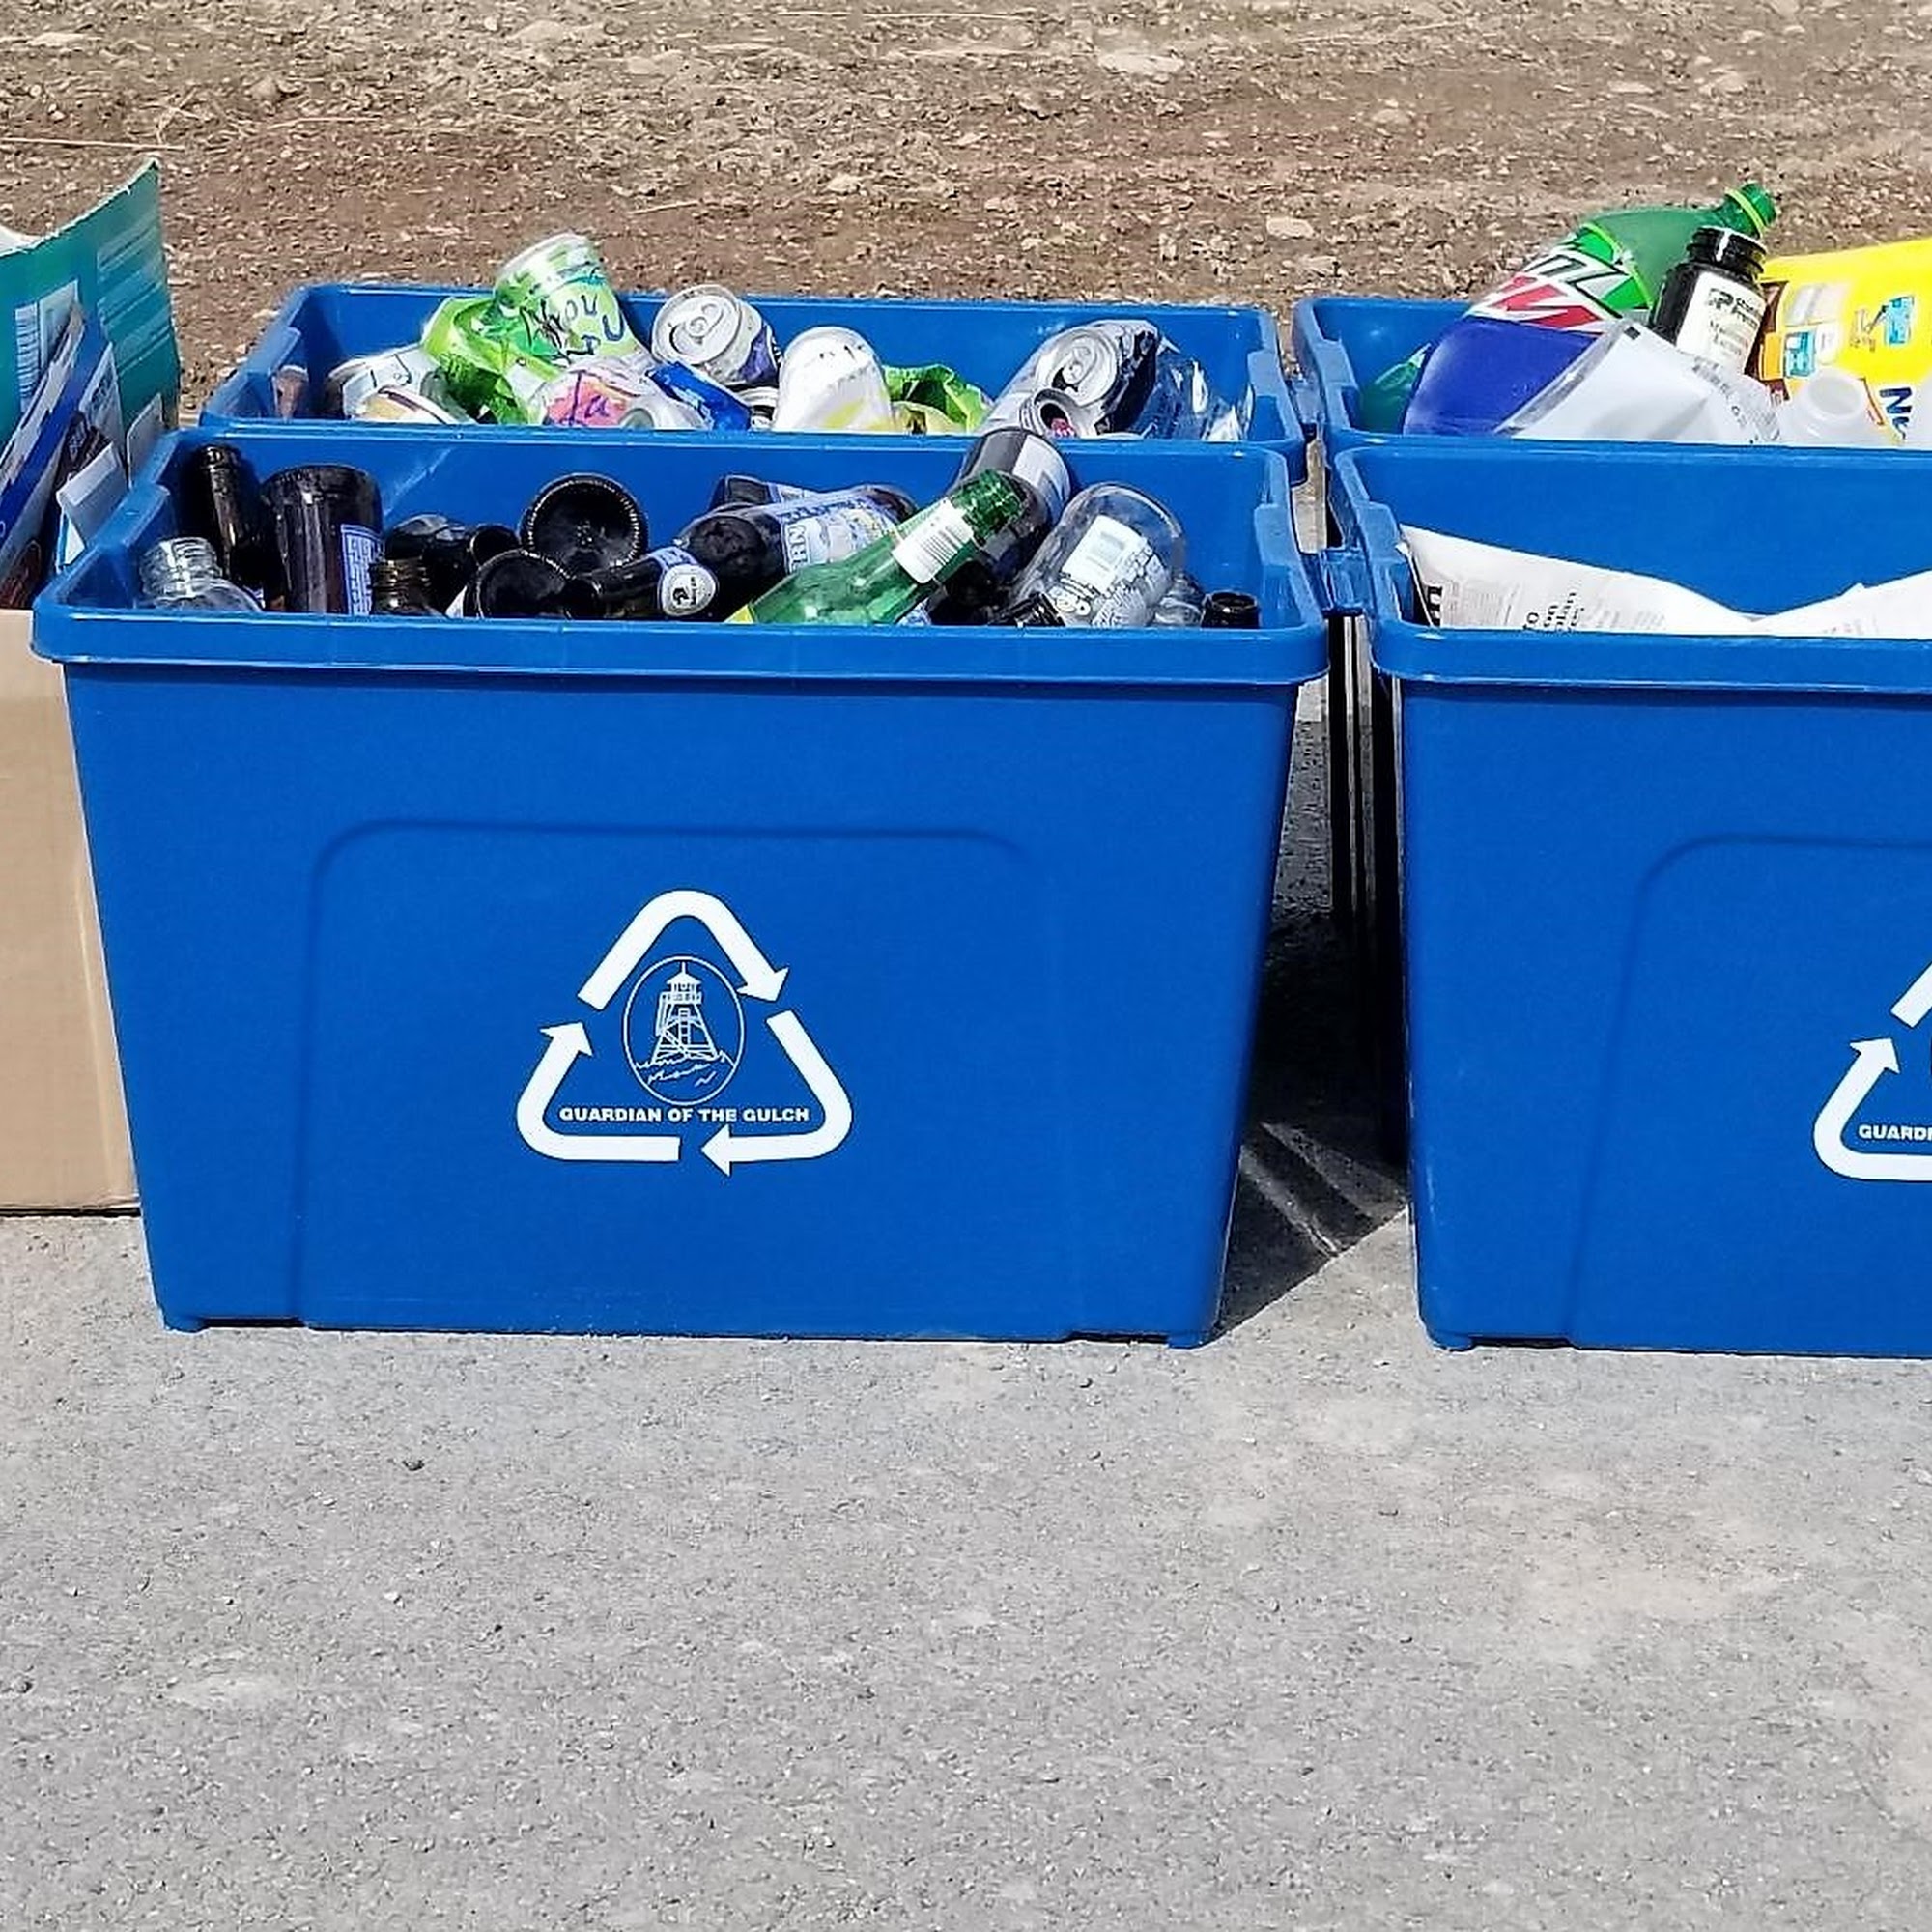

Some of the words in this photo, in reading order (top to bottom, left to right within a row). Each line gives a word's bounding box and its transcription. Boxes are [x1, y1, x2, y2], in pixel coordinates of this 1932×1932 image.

[559, 1107, 662, 1122] GUARDIAN
[668, 1107, 694, 1122] OF
[697, 1107, 737, 1122] THE
[742, 1107, 810, 1122] GULCH
